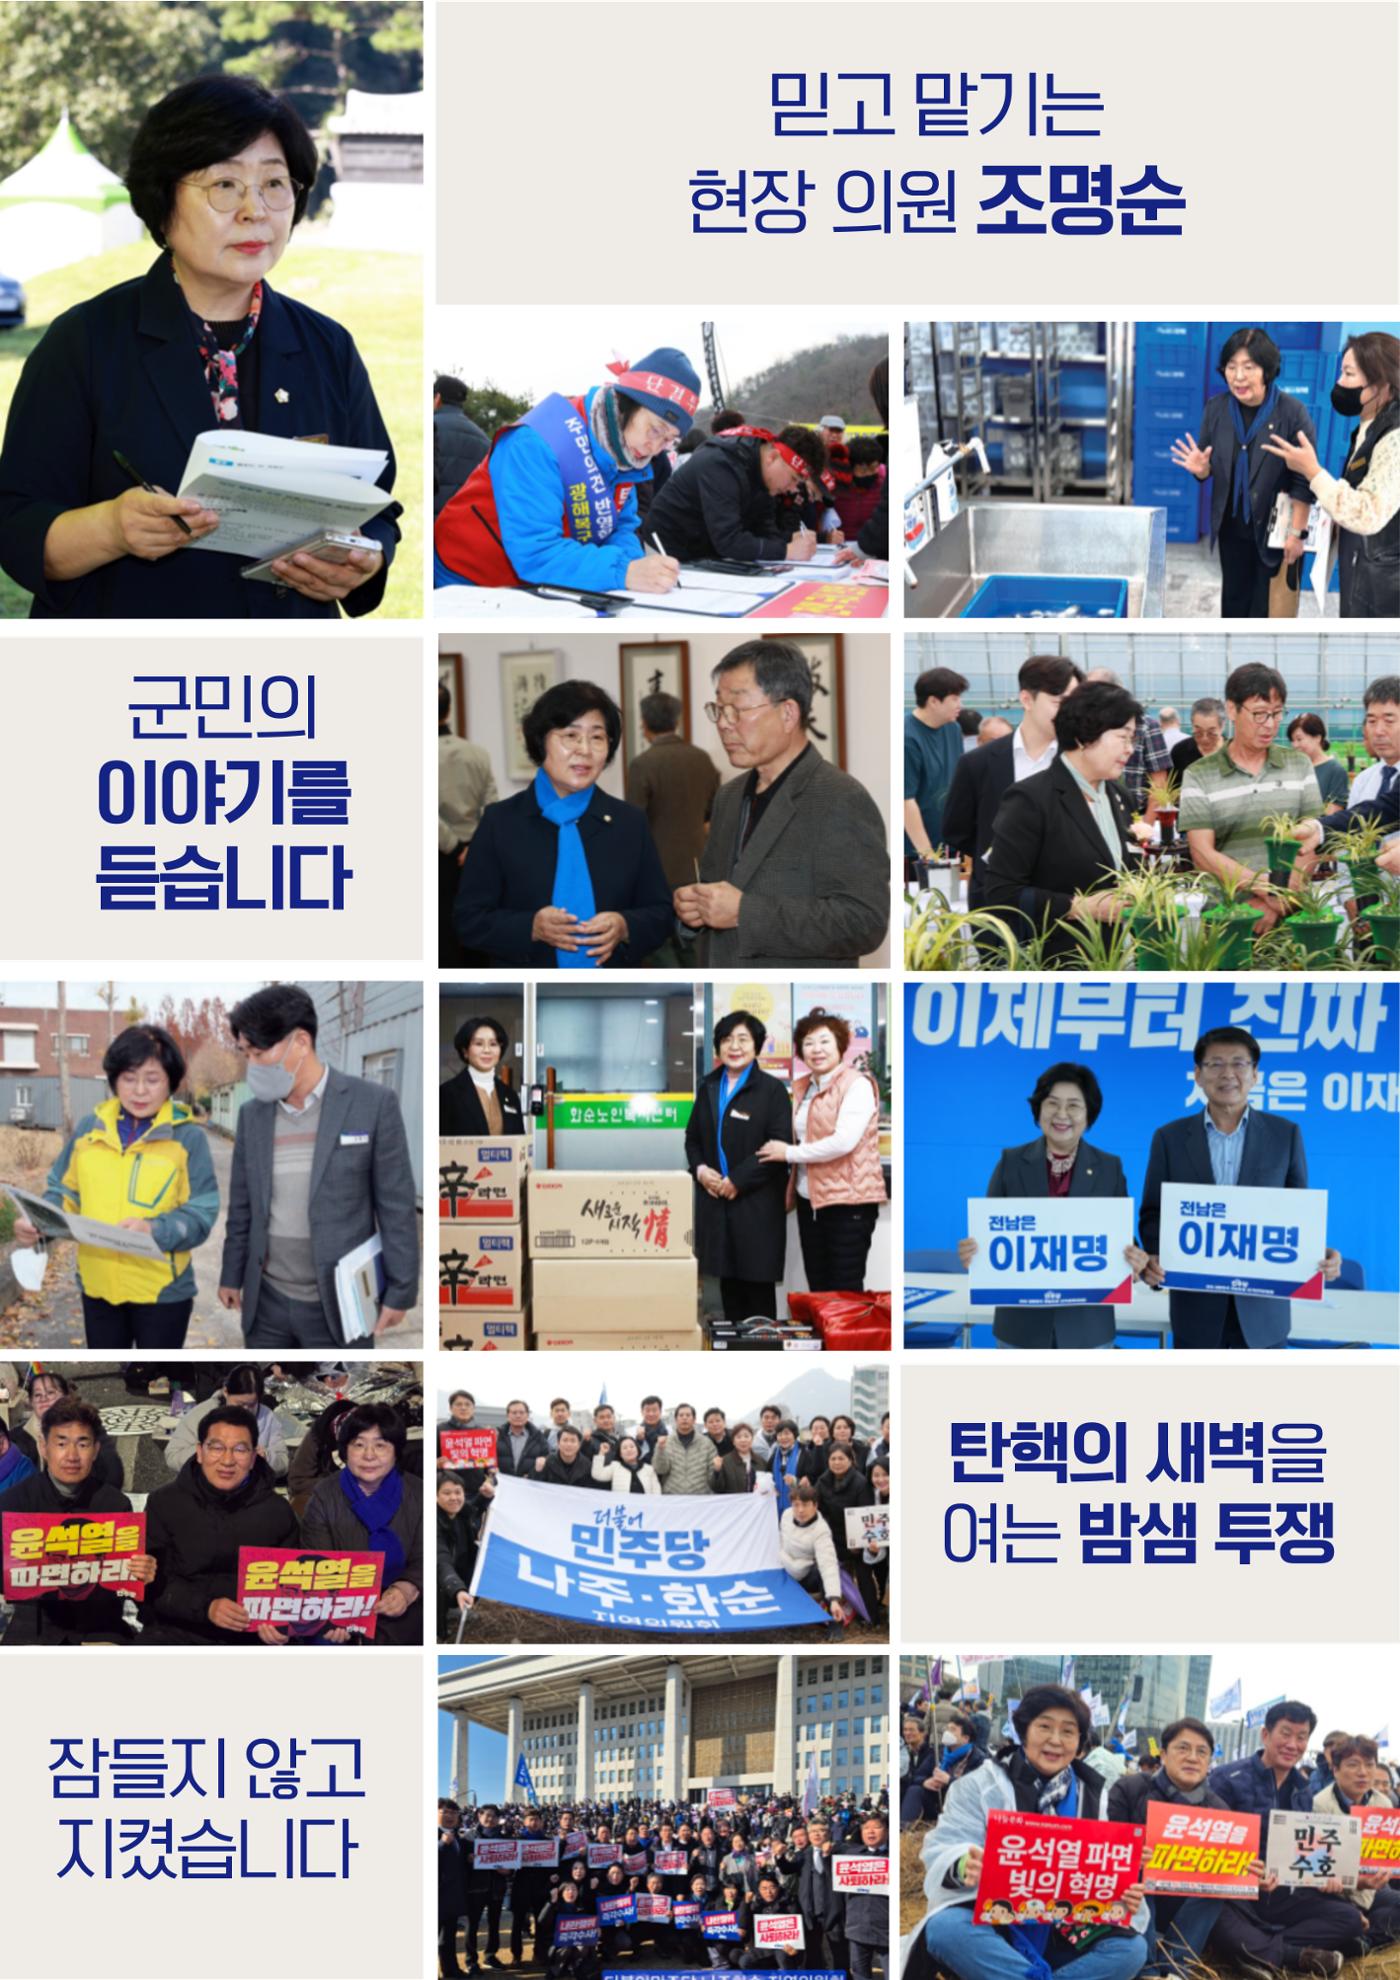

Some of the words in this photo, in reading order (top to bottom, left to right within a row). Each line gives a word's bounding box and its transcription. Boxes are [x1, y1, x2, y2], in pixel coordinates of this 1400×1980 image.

[911, 983, 1203, 1051] 이제부터
[1229, 983, 1388, 1053] 진짜
[988, 1215, 1037, 1232] 전남은
[1178, 1200, 1227, 1219] 전남은
[988, 1234, 1109, 1273] 이재명
[1178, 1221, 1300, 1265] 이재명
[593, 1506, 643, 1529] 더불어
[10, 1521, 140, 1560] 윤석열을
[571, 1523, 710, 1571] 민주당
[244, 1559, 377, 1591] 윤석열을
[242, 1594, 377, 1622] 파면하라!
[1162, 1814, 1249, 1845] 윤석열을
[1294, 1825, 1342, 1853] 민주
[997, 1834, 1082, 1869] 윤석열
[1085, 1842, 1133, 1872] 파면
[1147, 1844, 1256, 1877] 파면하라!
[1288, 1854, 1336, 1879] 수호
[1008, 1869, 1064, 1899] 빛의
[1069, 1872, 1118, 1900] 혁명
